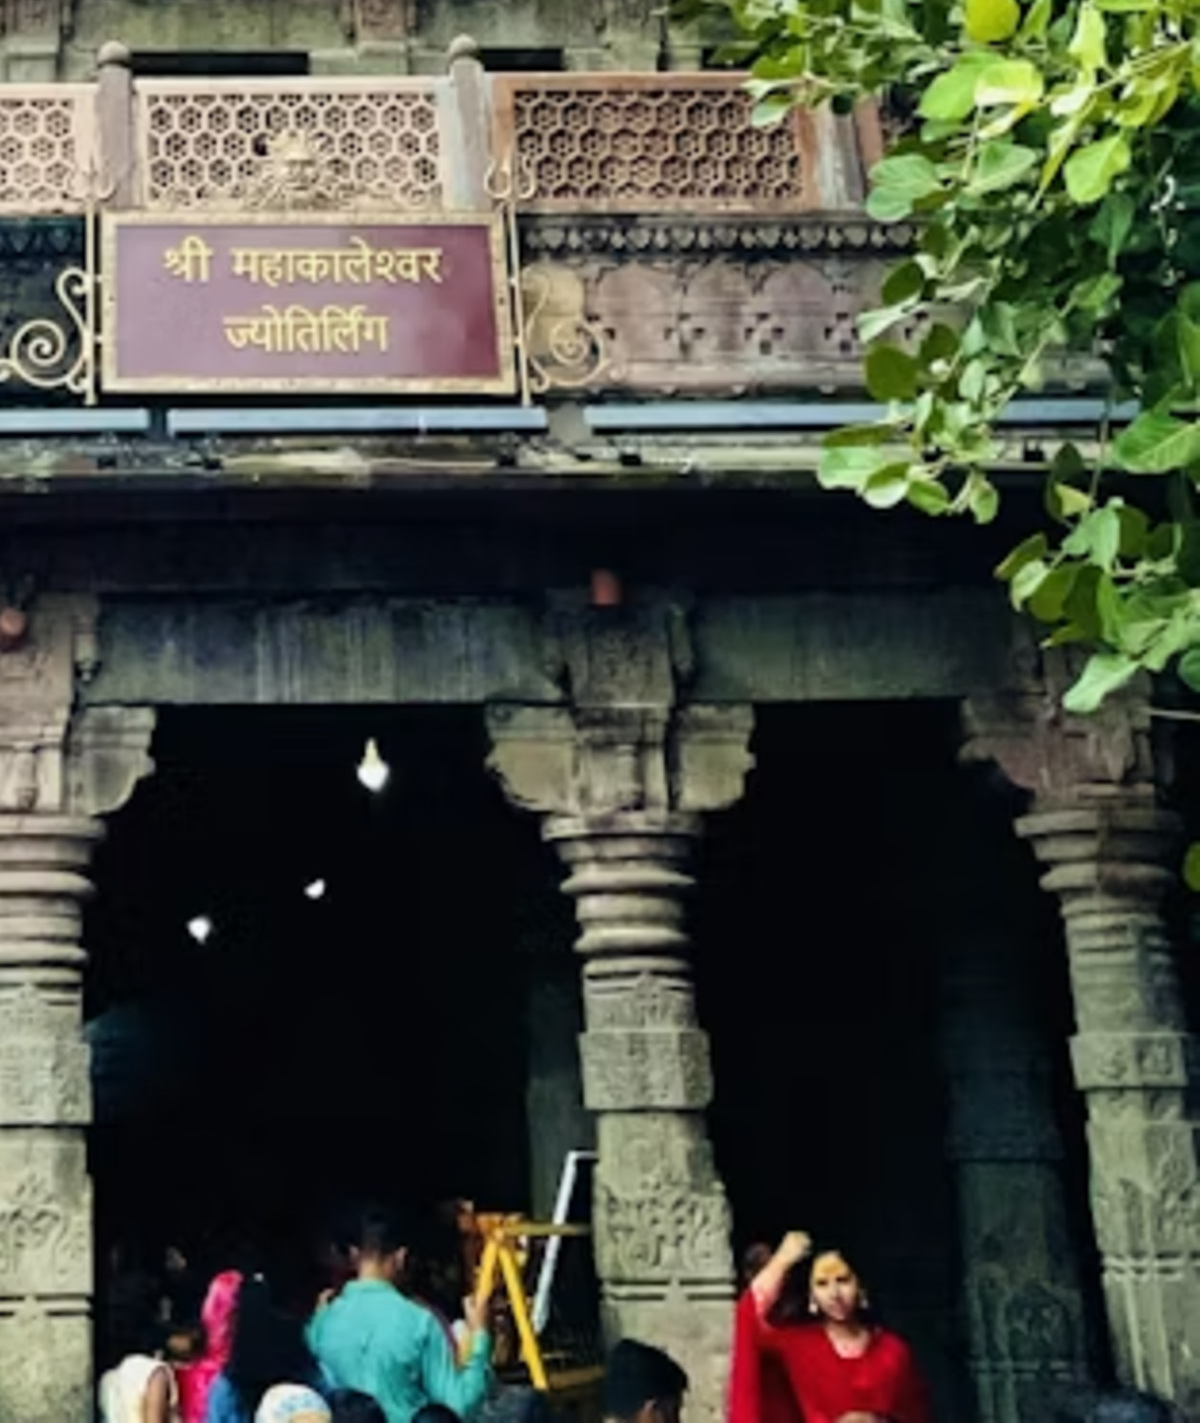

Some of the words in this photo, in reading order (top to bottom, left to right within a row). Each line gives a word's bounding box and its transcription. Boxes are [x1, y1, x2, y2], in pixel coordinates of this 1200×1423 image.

[163, 234, 214, 283] श्री
[230, 235, 444, 287] महाकालेश्वर
[223, 304, 390, 353] ज्योतिर्लिंग
